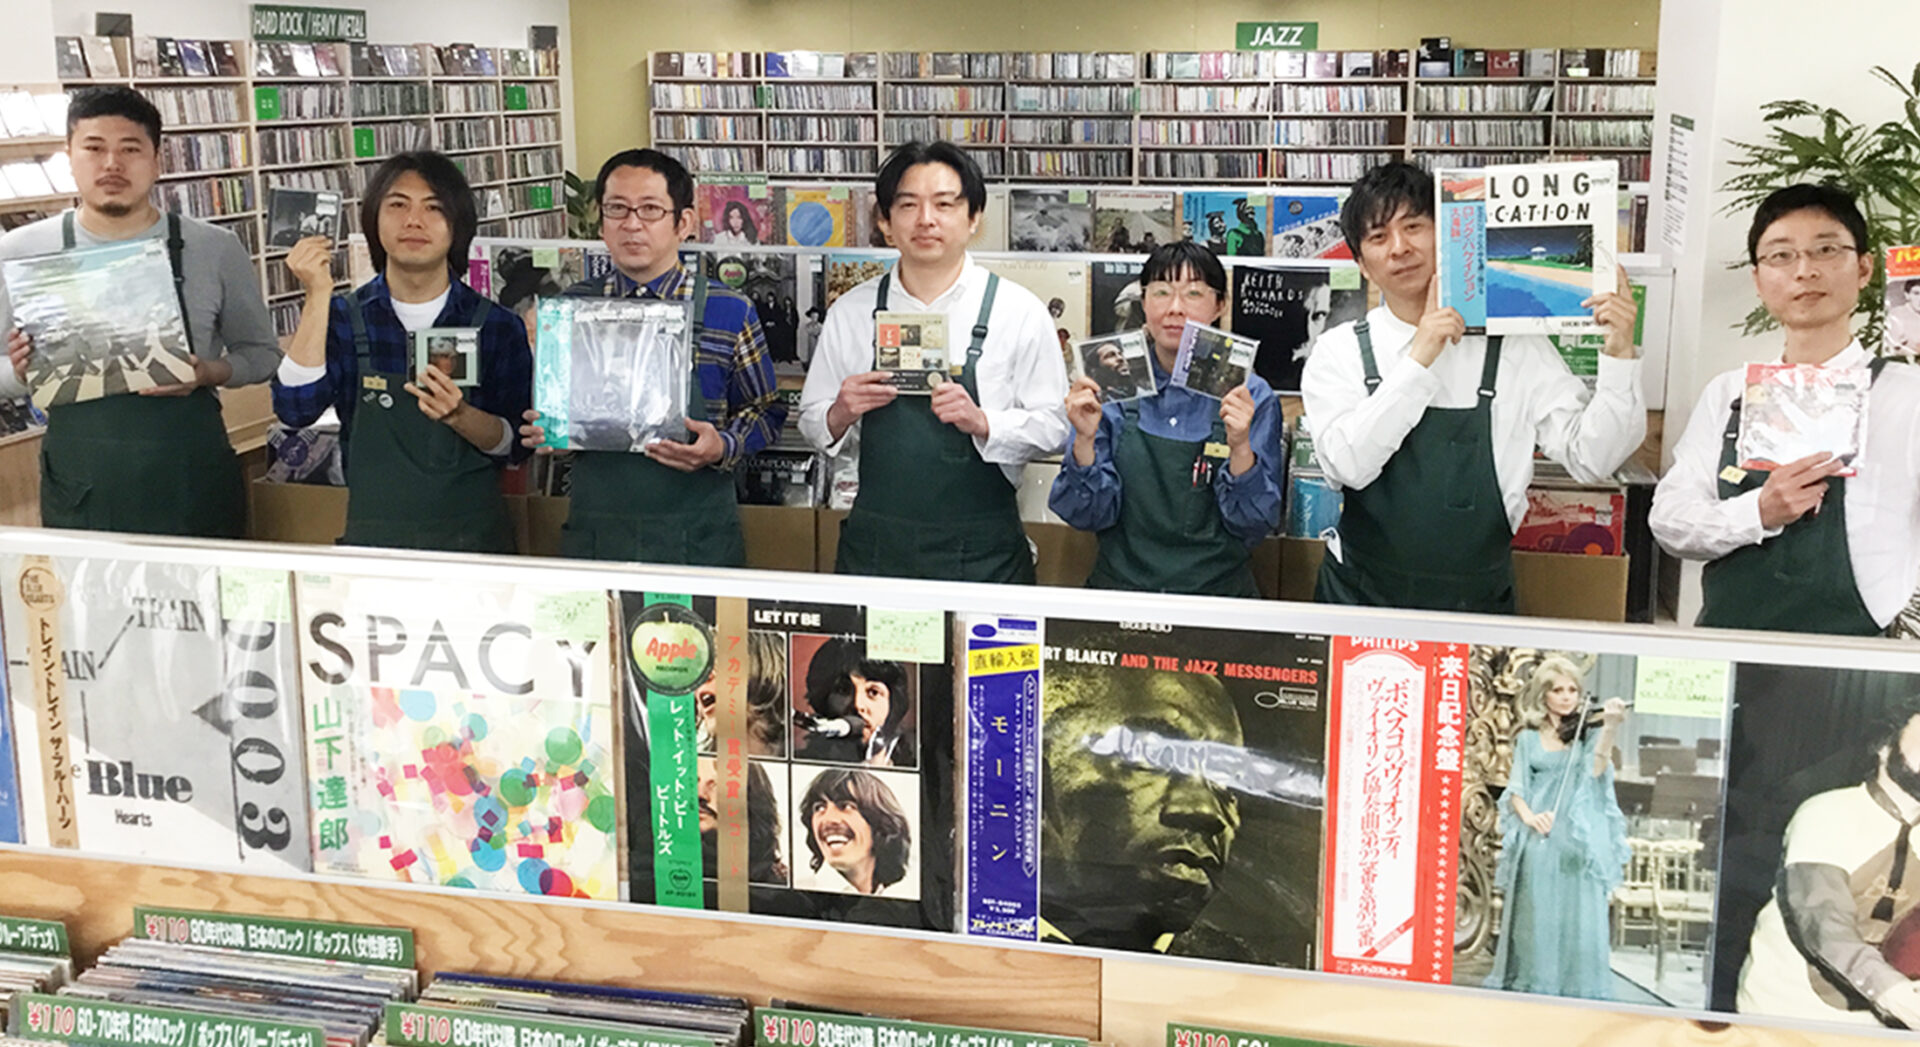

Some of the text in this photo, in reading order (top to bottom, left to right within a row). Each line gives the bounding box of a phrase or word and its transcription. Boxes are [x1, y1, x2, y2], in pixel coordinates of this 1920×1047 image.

[254, 11, 278, 35] HARD
[280, 12, 304, 36] ROCK
[312, 13, 338, 36] HEAVY
[338, 14, 365, 37] METAL
[1249, 26, 1304, 46] JAZZ
[1490, 172, 1590, 199] LONG
[1244, 272, 1283, 290] KEITH
[132, 596, 206, 632] TRAIN
[754, 610, 822, 627] LET IT BE
[307, 612, 597, 699] SPACY
[646, 637, 698, 663] Apple
[1351, 635, 1420, 652] PHILIPS
[1065, 648, 1118, 667] BLAKEY
[1120, 653, 1149, 669] AND
[1153, 656, 1180, 672] THE
[1184, 658, 1219, 676] JAZZ
[1224, 662, 1318, 685] MESSENGERS
[1435, 654, 1464, 772] 来日記念盤
[312, 696, 350, 851] 山下達郎
[669, 699, 688, 829] レット・イット・ビー
[84, 759, 193, 804] Blue
[989, 715, 1010, 862] モーニン
[115, 808, 153, 828] Hearts
[655, 785, 674, 855] ビートルズ
[144, 914, 189, 942] ¥110
[247, 924, 303, 951] 日本のロック
[27, 1002, 75, 1036] ¥110
[132, 1011, 187, 1046] 日本のロック
[400, 1011, 451, 1044] ¥110
[762, 1015, 815, 1046] ¥110
[1174, 1029, 1230, 1047] ¥110
